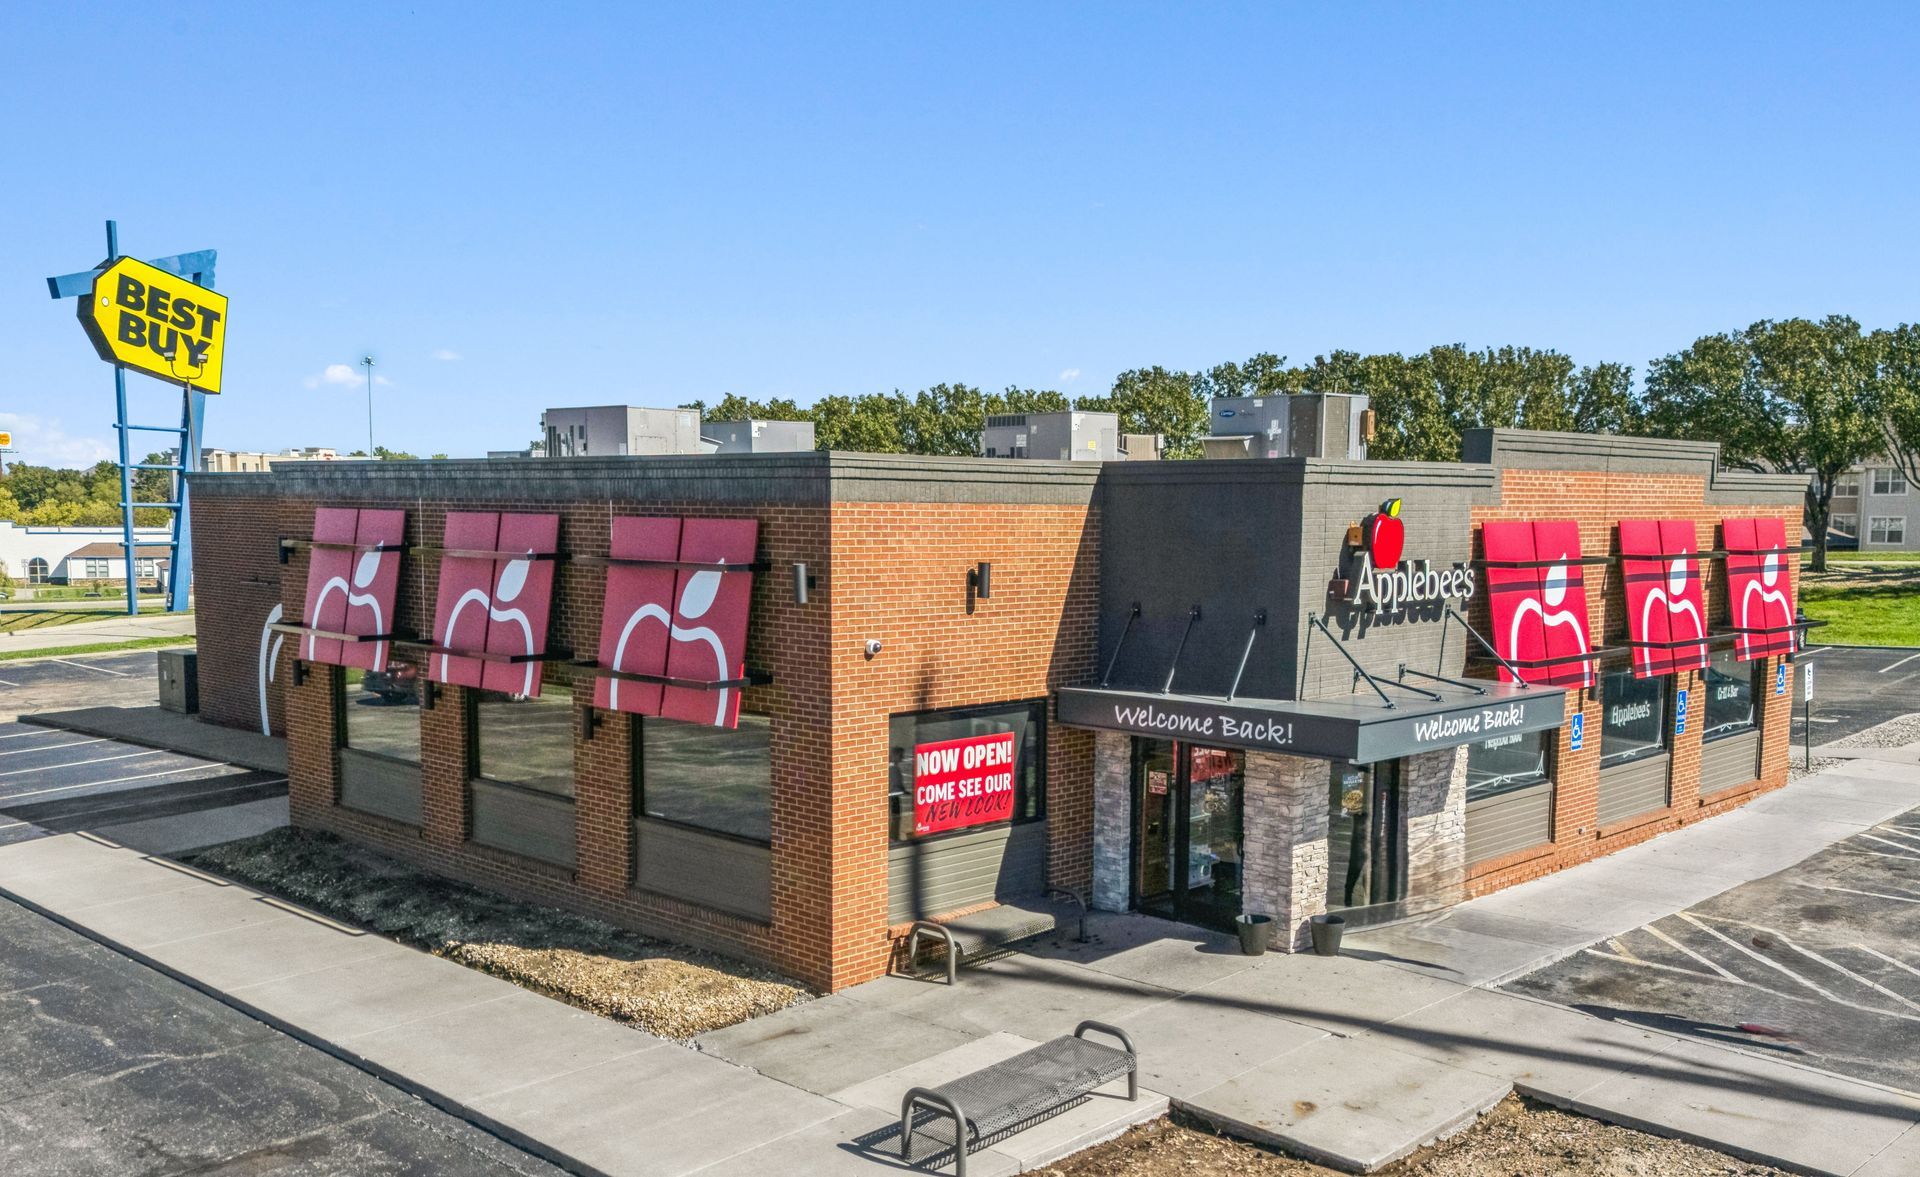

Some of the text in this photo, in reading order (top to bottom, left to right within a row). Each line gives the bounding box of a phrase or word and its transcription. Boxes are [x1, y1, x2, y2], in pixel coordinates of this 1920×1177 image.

[116, 273, 221, 339] BEST
[118, 310, 212, 368] BUY
[1353, 551, 1475, 614] Applebee's
[1114, 704, 1293, 744] Welcome Back!
[1415, 714, 1480, 742] Welcome
[1482, 703, 1524, 730] Back!
[1612, 700, 1650, 727] Applebee's
[916, 740, 1013, 777] NOW OPEN!
[917, 773, 1012, 806] COME SEE OUR
[925, 791, 1012, 823] NEW LOOK!
